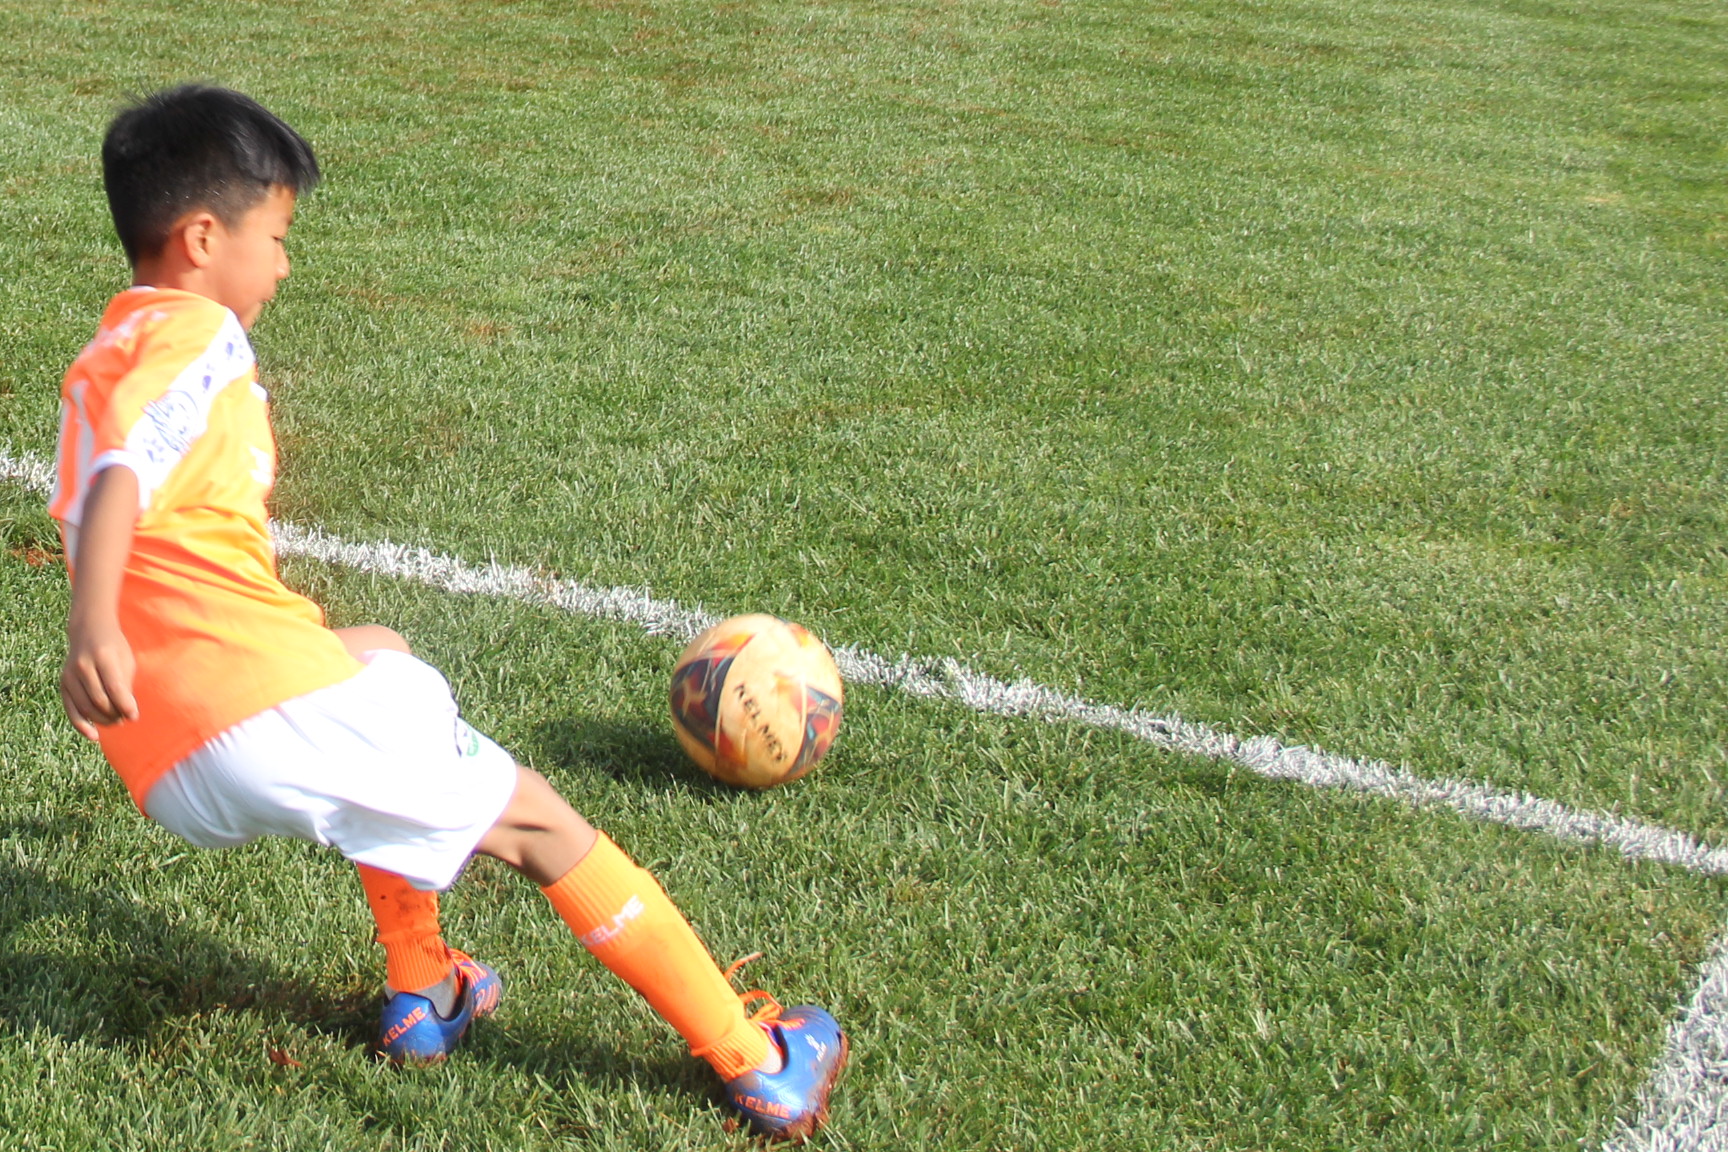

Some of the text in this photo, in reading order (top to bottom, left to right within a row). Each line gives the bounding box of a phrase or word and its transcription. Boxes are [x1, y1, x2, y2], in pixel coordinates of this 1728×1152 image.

[580, 893, 645, 947] KELME
[382, 1006, 428, 1047] KELME
[735, 1093, 792, 1119] KELME
